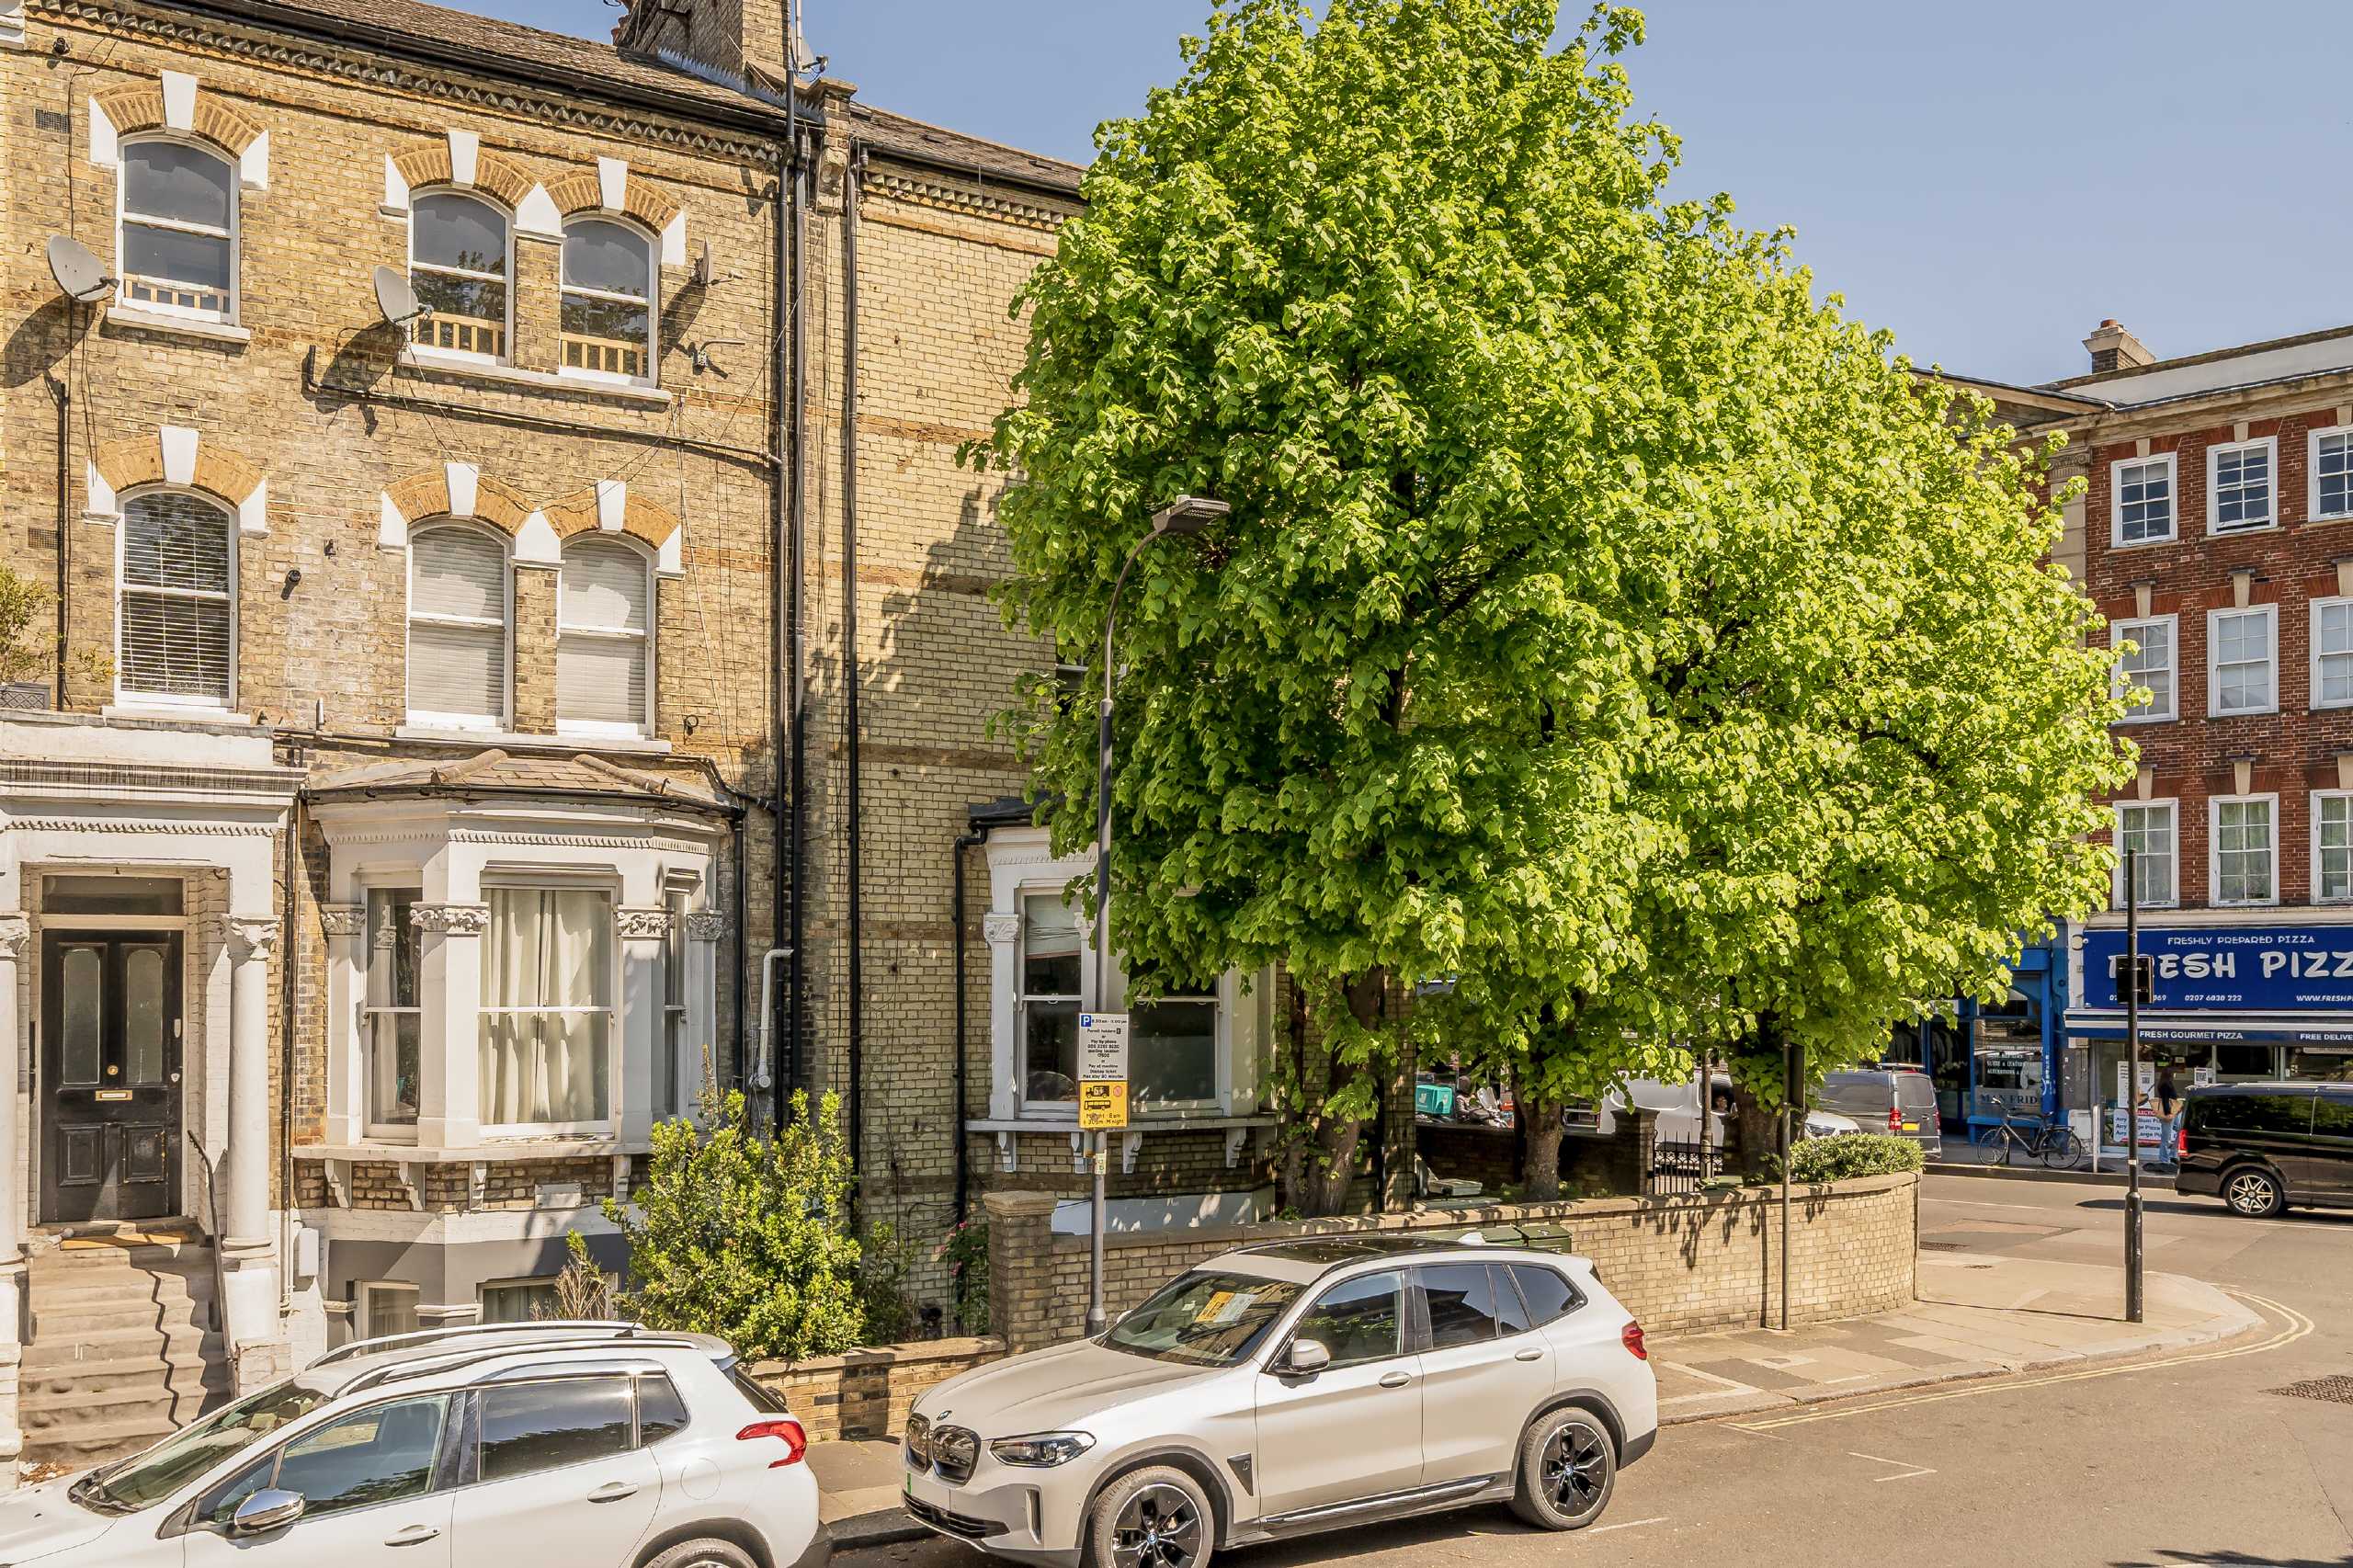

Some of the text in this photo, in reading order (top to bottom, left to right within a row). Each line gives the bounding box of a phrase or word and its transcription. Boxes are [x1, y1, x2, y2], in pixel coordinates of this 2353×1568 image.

[2167, 935, 2315, 946] FRESHLY PREPARED PIZZA
[1083, 1016, 1090, 1027] P
[2139, 1030, 2244, 1040] FRESH GOURMET PIZZA
